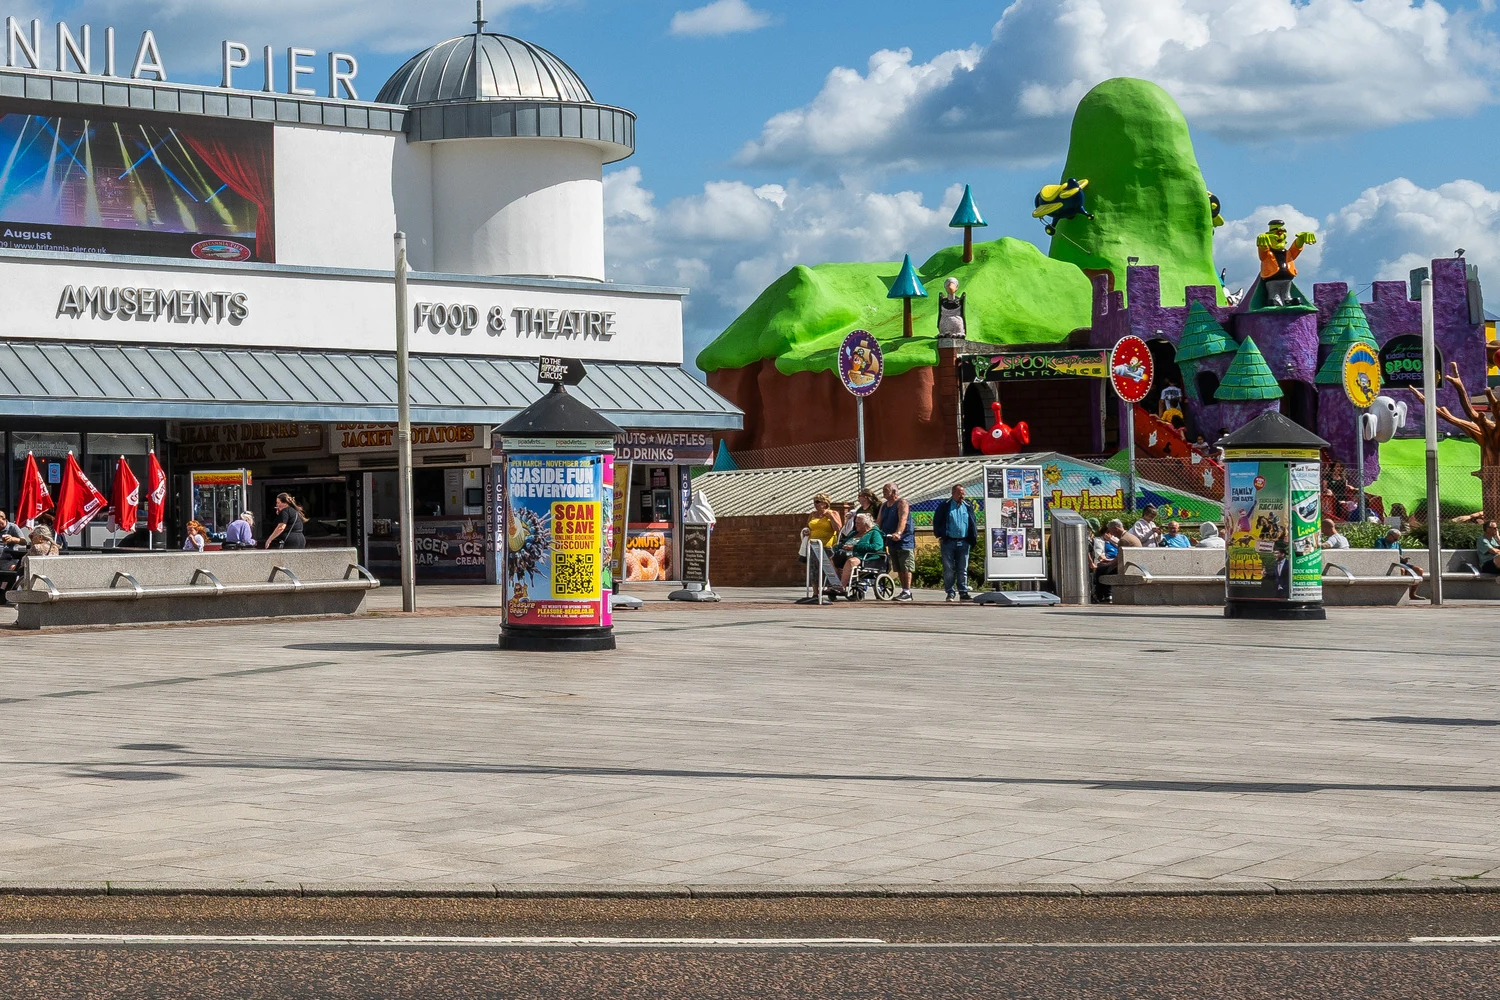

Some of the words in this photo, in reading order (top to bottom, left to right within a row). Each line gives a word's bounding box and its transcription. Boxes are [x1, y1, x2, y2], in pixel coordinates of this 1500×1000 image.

[221, 39, 358, 100] PIER
[3, 228, 52, 240] August
[59, 284, 250, 321] AMUSEMENTS
[415, 302, 480, 331] FOOD
[488, 305, 507, 332] &
[513, 306, 617, 338] THEATRE
[1002, 355, 1056, 370] SPOOK
[1385, 358, 1423, 374] SPOO
[540, 371, 563, 380] CIRCUS
[1003, 367, 1102, 378] ENTRANCE
[240, 422, 299, 441] DRINKS
[341, 429, 393, 448] JACKET
[411, 425, 475, 445] OTATOES
[656, 433, 706, 446] WAFFLES
[613, 448, 630, 461] OLD
[633, 448, 674, 461] DRINKS
[511, 468, 564, 484] SEASIDE
[566, 468, 594, 484] FUN
[511, 484, 528, 498] FOR
[528, 484, 594, 498] EVERYONE!
[1232, 487, 1253, 496] FAMILY
[1048, 489, 1126, 512] Joyland
[554, 504, 594, 520] SCAN
[485, 505, 494, 551] CREAM
[555, 521, 564, 534] &
[565, 521, 594, 534] SAVE
[459, 542, 483, 556] ICE
[555, 541, 594, 549] DISCOUNT
[626, 535, 661, 550] DONUTS
[456, 556, 485, 566] CREAM
[1229, 559, 1263, 570] RACE
[1229, 569, 1263, 580] DAYS
